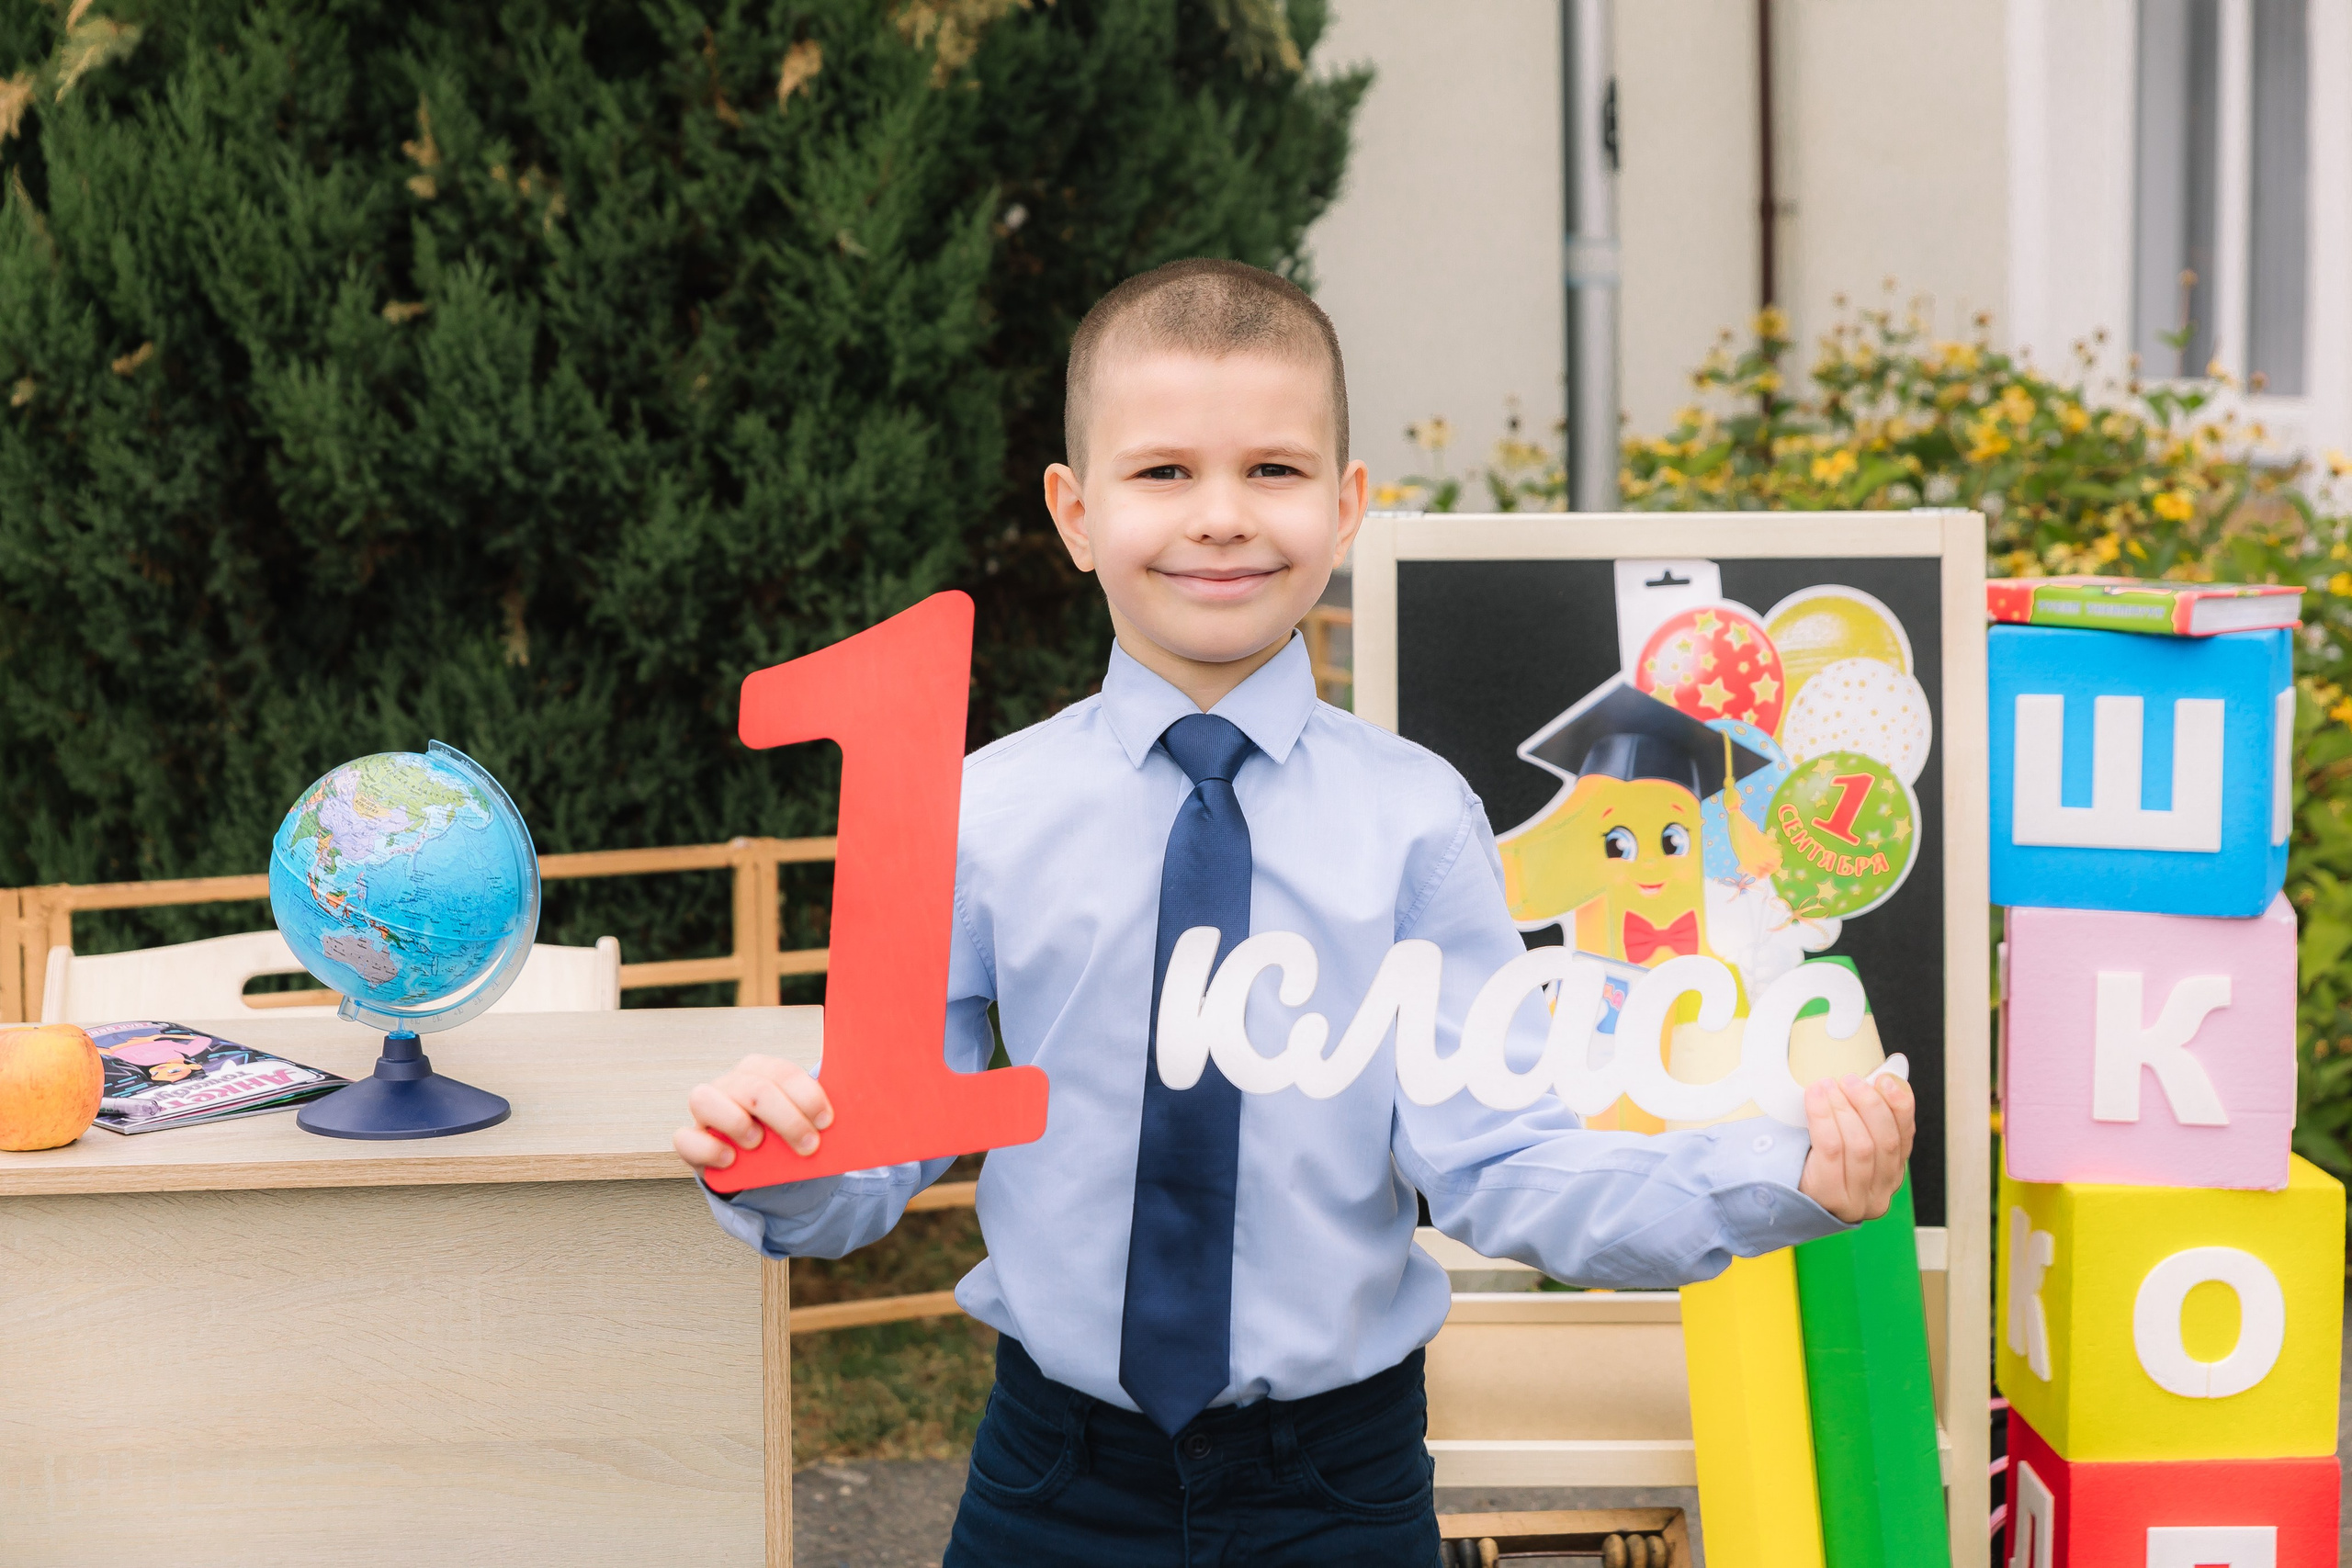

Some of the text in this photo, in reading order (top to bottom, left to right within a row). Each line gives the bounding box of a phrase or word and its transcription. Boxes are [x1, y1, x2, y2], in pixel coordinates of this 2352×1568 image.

[1778, 773, 1891, 877] 1 СЕНТЯБРЯ
[2012, 694, 2225, 852] Ш
[704, 590, 1049, 1193] 1
[2093, 971, 2232, 1127] К
[2133, 1246, 2285, 1398] О
